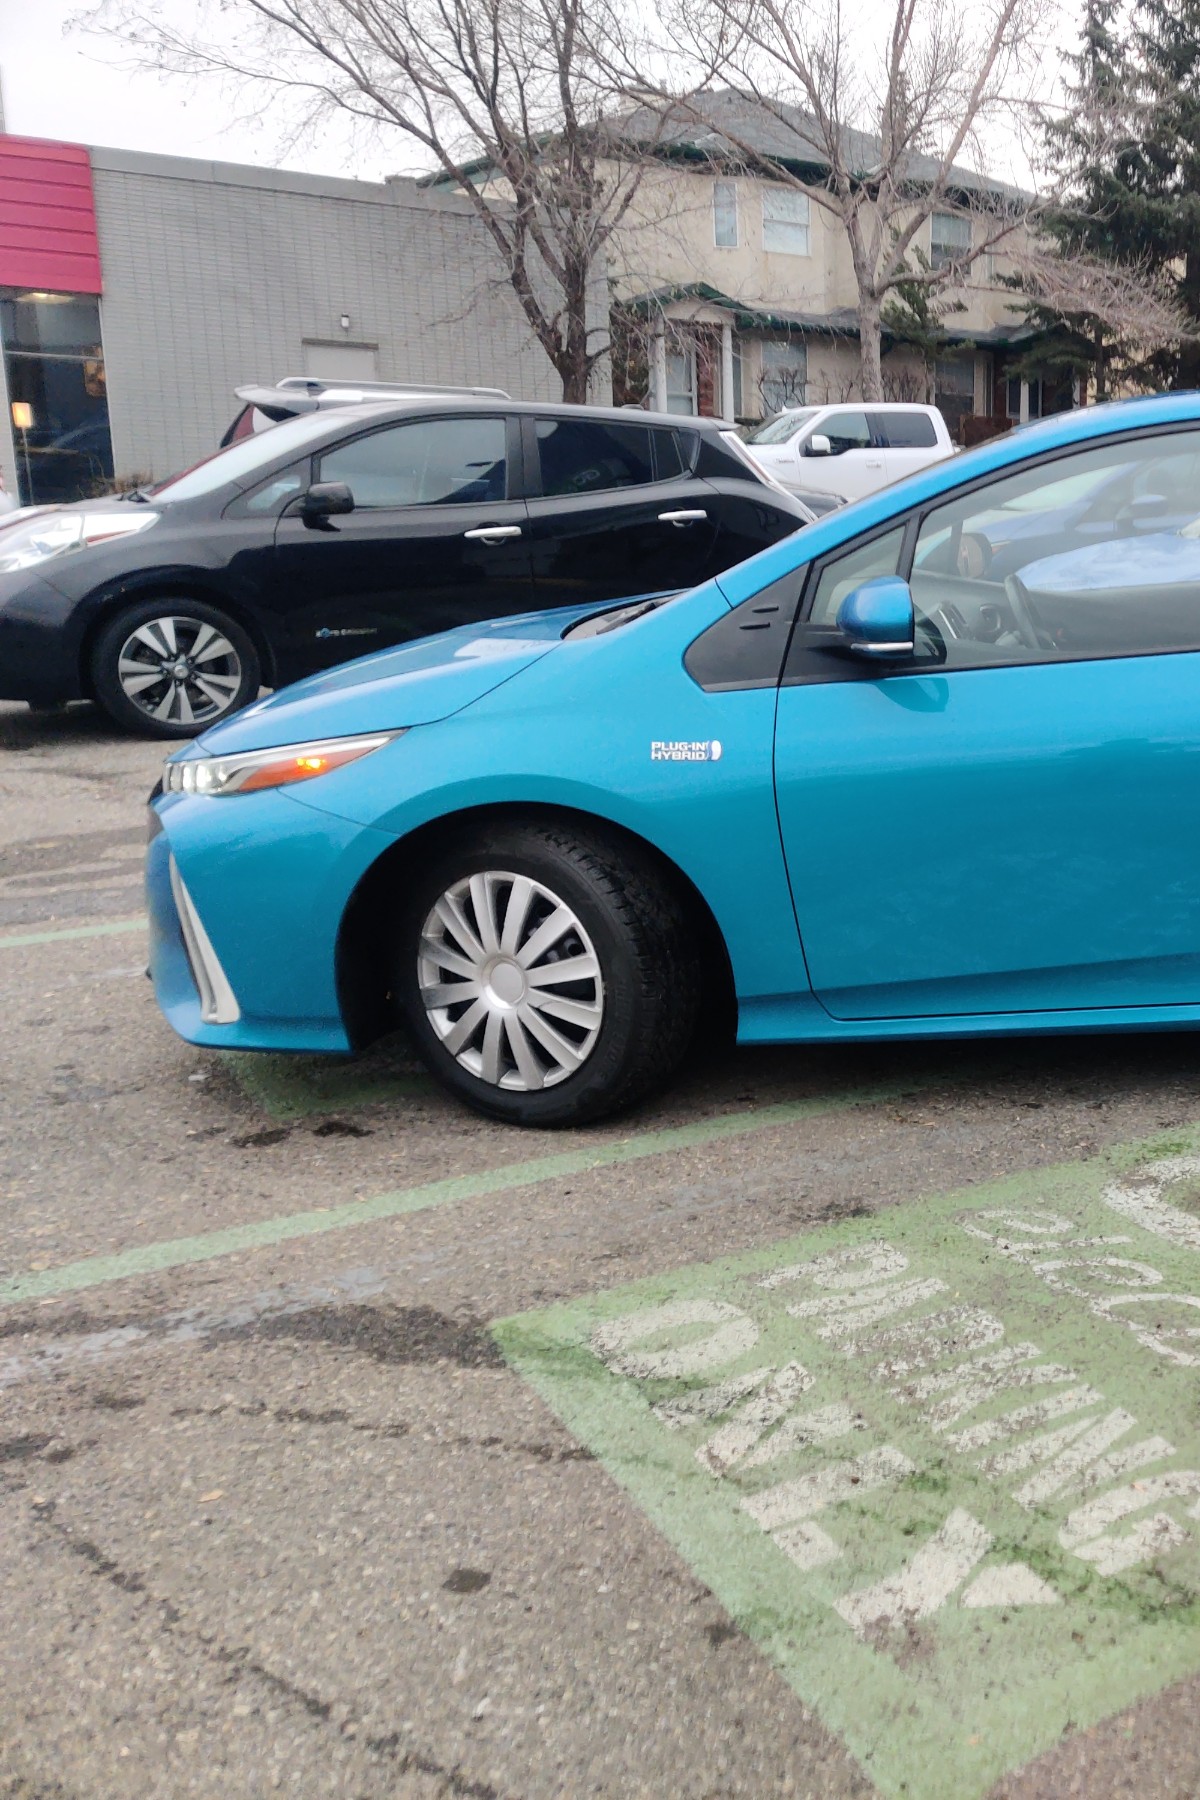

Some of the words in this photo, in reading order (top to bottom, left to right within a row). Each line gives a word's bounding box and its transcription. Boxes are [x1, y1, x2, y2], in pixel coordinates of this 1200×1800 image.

[651, 741, 706, 751] PLUG-IN
[651, 751, 706, 760] HYBRID
[593, 1299, 1063, 1634] ONLY
